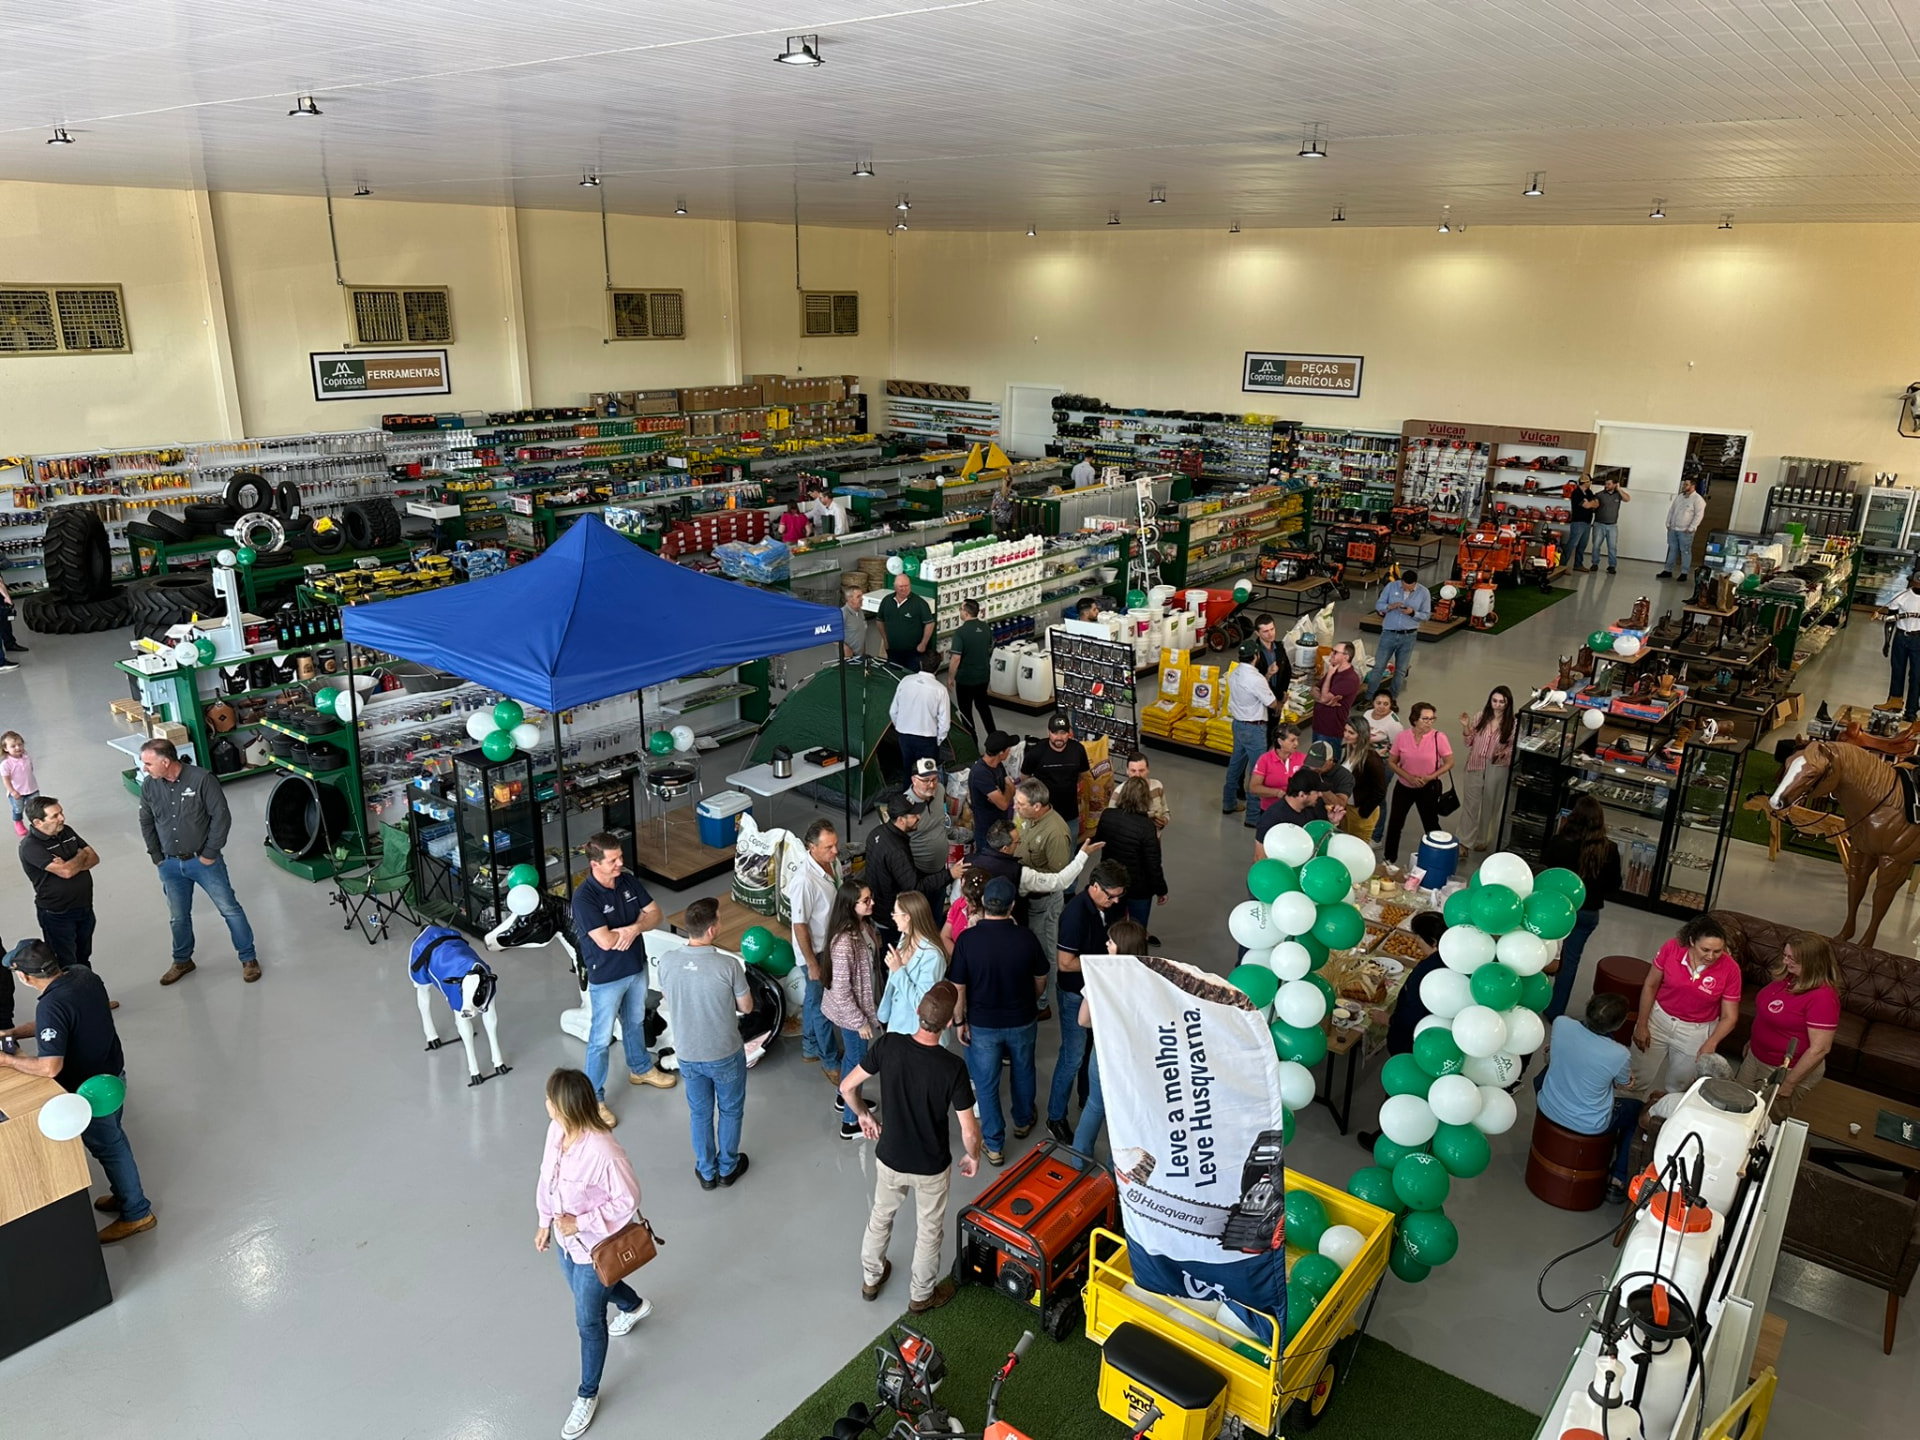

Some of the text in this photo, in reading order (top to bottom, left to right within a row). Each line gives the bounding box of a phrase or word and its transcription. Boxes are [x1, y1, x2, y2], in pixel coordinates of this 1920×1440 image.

[367, 368, 440, 380] FERRAMENTAS
[1301, 363, 1338, 375] PEÇAS
[323, 376, 365, 387] Coprossel
[1250, 372, 1284, 382] Coprossel
[1286, 374, 1351, 388] AGRÍCOLAS
[1428, 423, 1466, 435] Vulcan
[1520, 430, 1560, 443] Vulcan
[750, 897, 766, 905] LEITE
[1155, 1021, 1189, 1177] Leve a melhor.
[1184, 1008, 1217, 1187] Leve Husqvarna.
[1140, 1195, 1205, 1226] Husqvarna
